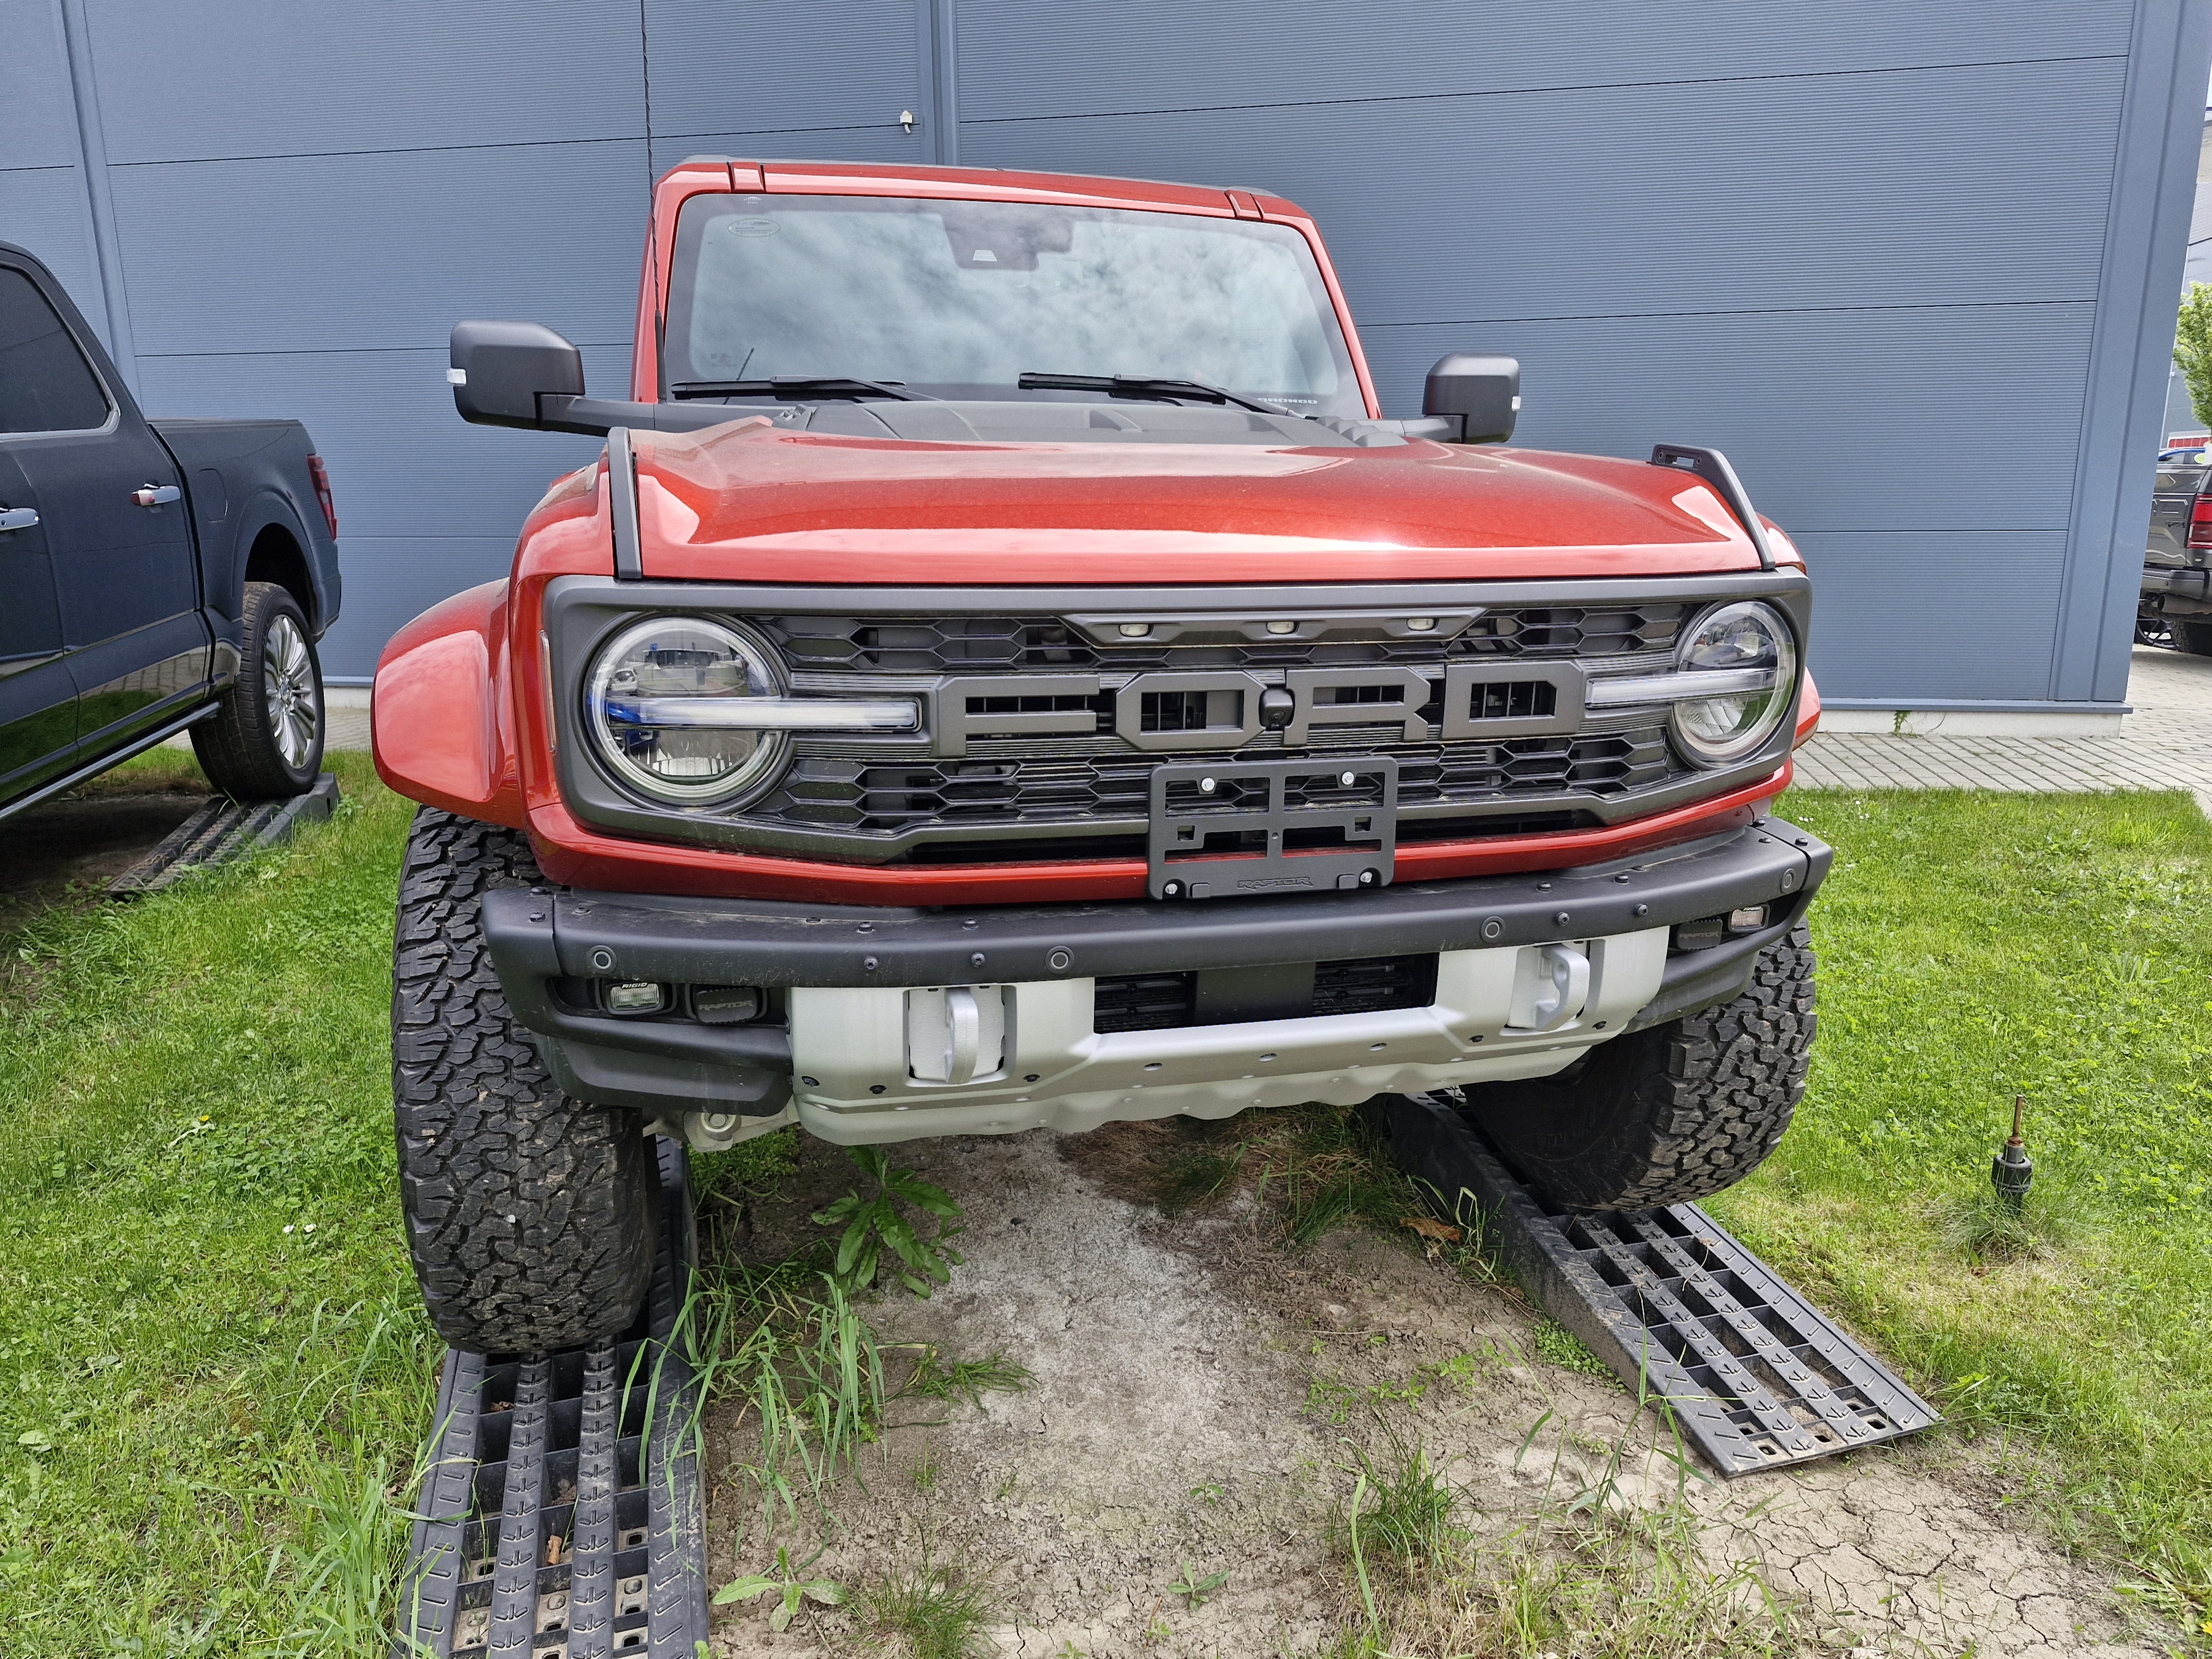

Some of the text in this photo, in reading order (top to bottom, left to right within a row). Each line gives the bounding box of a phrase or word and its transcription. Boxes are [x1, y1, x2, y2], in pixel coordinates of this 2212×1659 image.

[937, 660, 1583, 757] FORD
[1237, 876, 1314, 891] RAPTOR
[698, 1000, 754, 1011] RAPTOR
